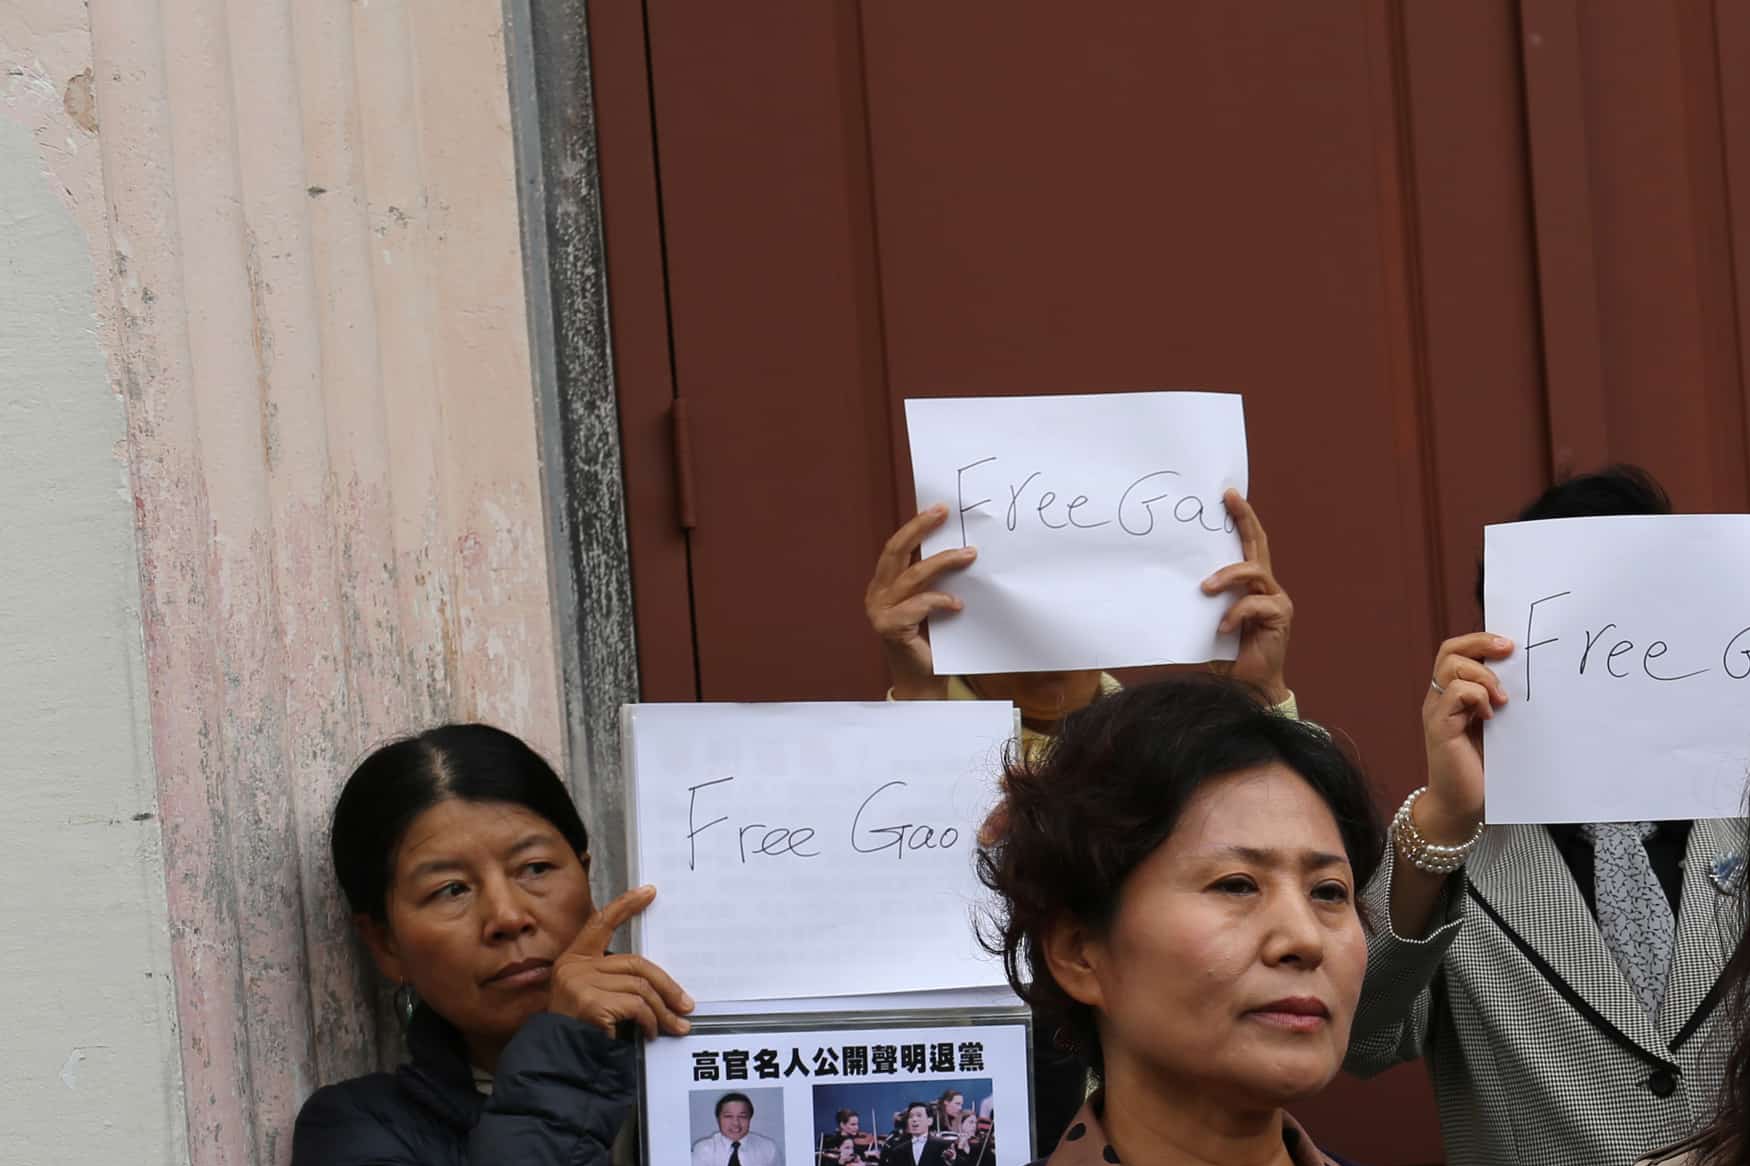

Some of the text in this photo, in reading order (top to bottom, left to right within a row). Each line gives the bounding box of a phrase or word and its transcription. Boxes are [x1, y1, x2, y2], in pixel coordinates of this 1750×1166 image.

[957, 456, 1112, 548] Free
[1525, 591, 1710, 702] Free
[687, 776, 959, 871] Free Gao
[691, 1041, 985, 1082] 高官名人公開聲明退黨
